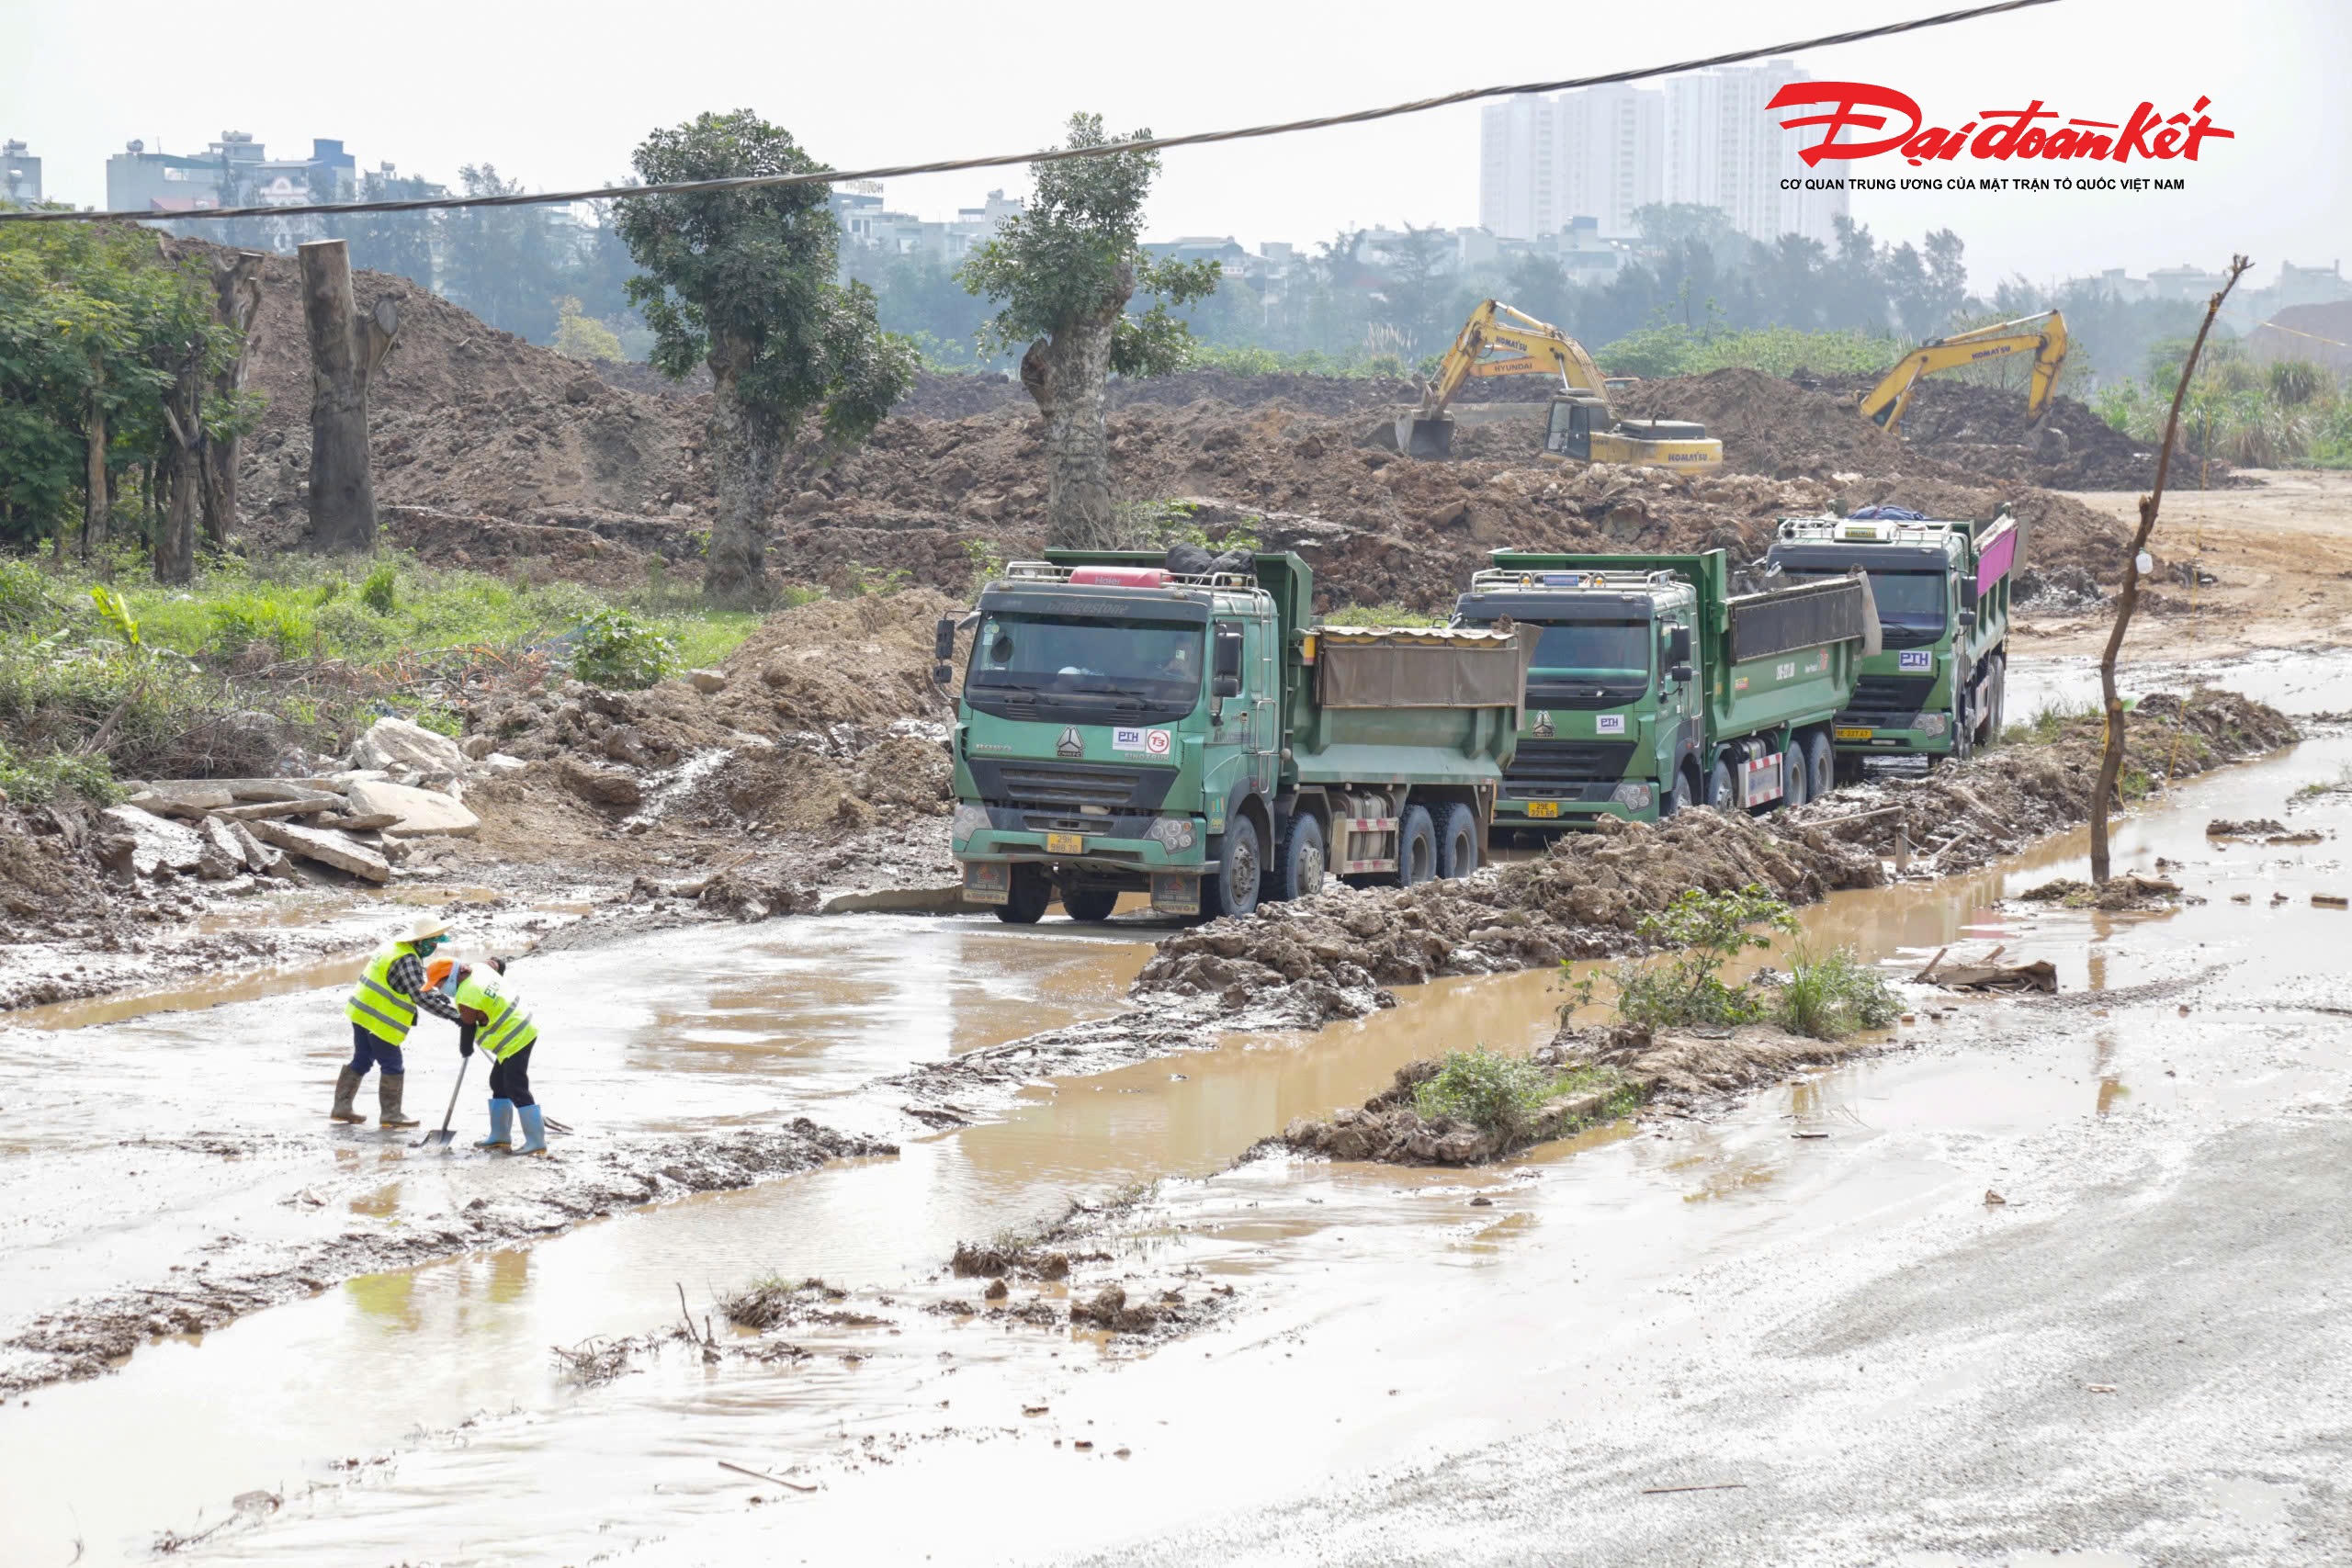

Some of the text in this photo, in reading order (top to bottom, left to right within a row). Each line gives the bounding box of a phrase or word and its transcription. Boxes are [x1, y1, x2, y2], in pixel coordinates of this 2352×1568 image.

[1496, 335, 1528, 351] KOMATSU
[1972, 345, 2011, 359] KOMATSU
[1494, 363, 1532, 372] HYUNDAI
[1668, 452, 1708, 462] KOMATSU
[1094, 575, 1122, 586] Haier
[1900, 652, 1929, 667] PTH
[1600, 717, 1619, 728] PTH
[1118, 731, 1139, 742] PTH
[1151, 736, 1166, 747] T3
